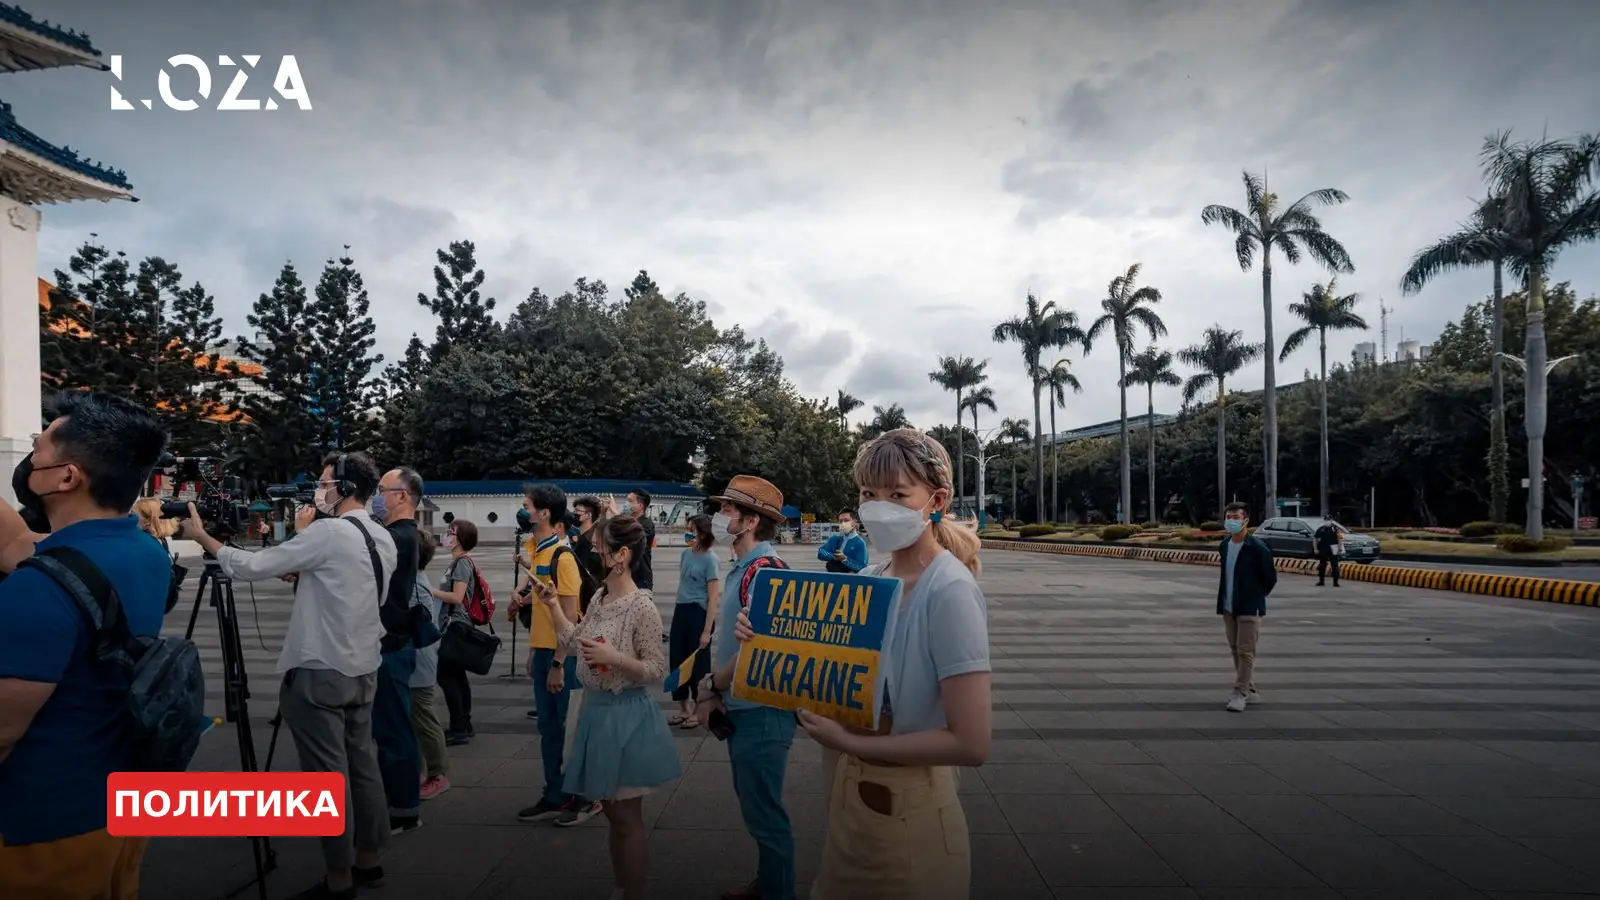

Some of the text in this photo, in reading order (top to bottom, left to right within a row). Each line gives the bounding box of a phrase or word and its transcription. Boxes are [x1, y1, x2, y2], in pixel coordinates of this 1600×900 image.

[768, 578, 873, 625] TAIWAN
[770, 617, 853, 645] STANDS WITH
[746, 648, 869, 710] UKRAINE
